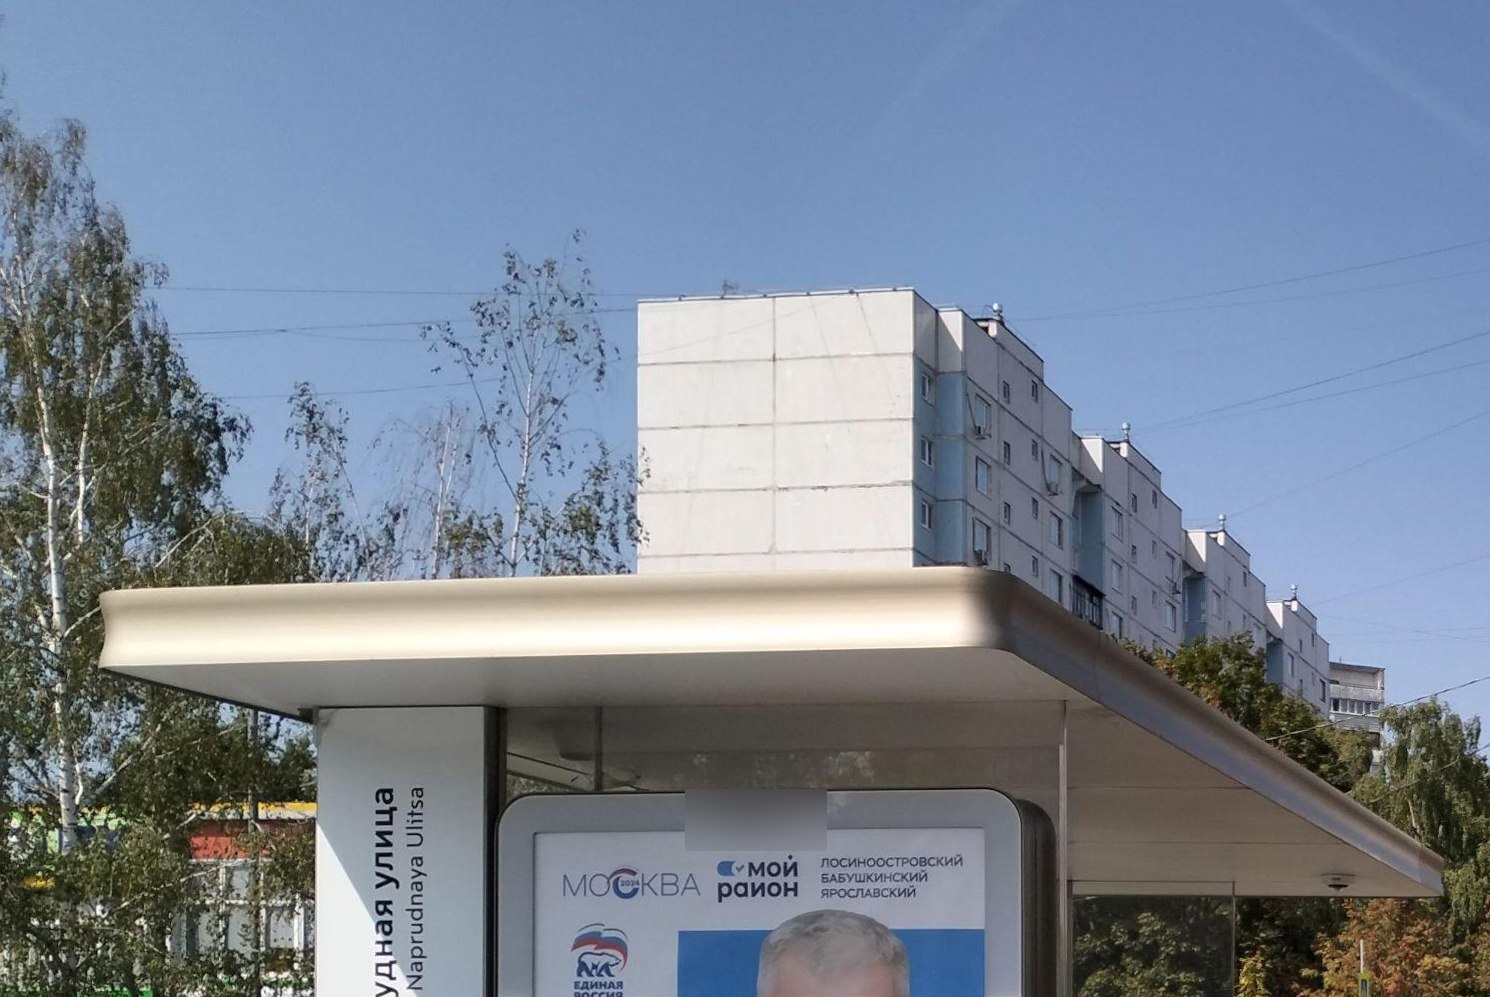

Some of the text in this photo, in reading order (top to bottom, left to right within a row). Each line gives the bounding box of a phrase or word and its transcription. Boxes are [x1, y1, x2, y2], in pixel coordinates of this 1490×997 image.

[405, 787, 425, 847] Ulitsa
[374, 787, 400, 890] улица
[748, 854, 798, 877] мой
[820, 854, 964, 868] ЛОСИНООСТРОВСКИЙ
[562, 868, 701, 899] МОСКВА
[820, 870, 928, 883] БАБУШКИНСКИЙ
[820, 885, 917, 898] ЯРОСЛАВСКИЙ
[405, 855, 428, 991] Naprudnaya
[573, 981, 624, 990] ЕДИНАЯ
